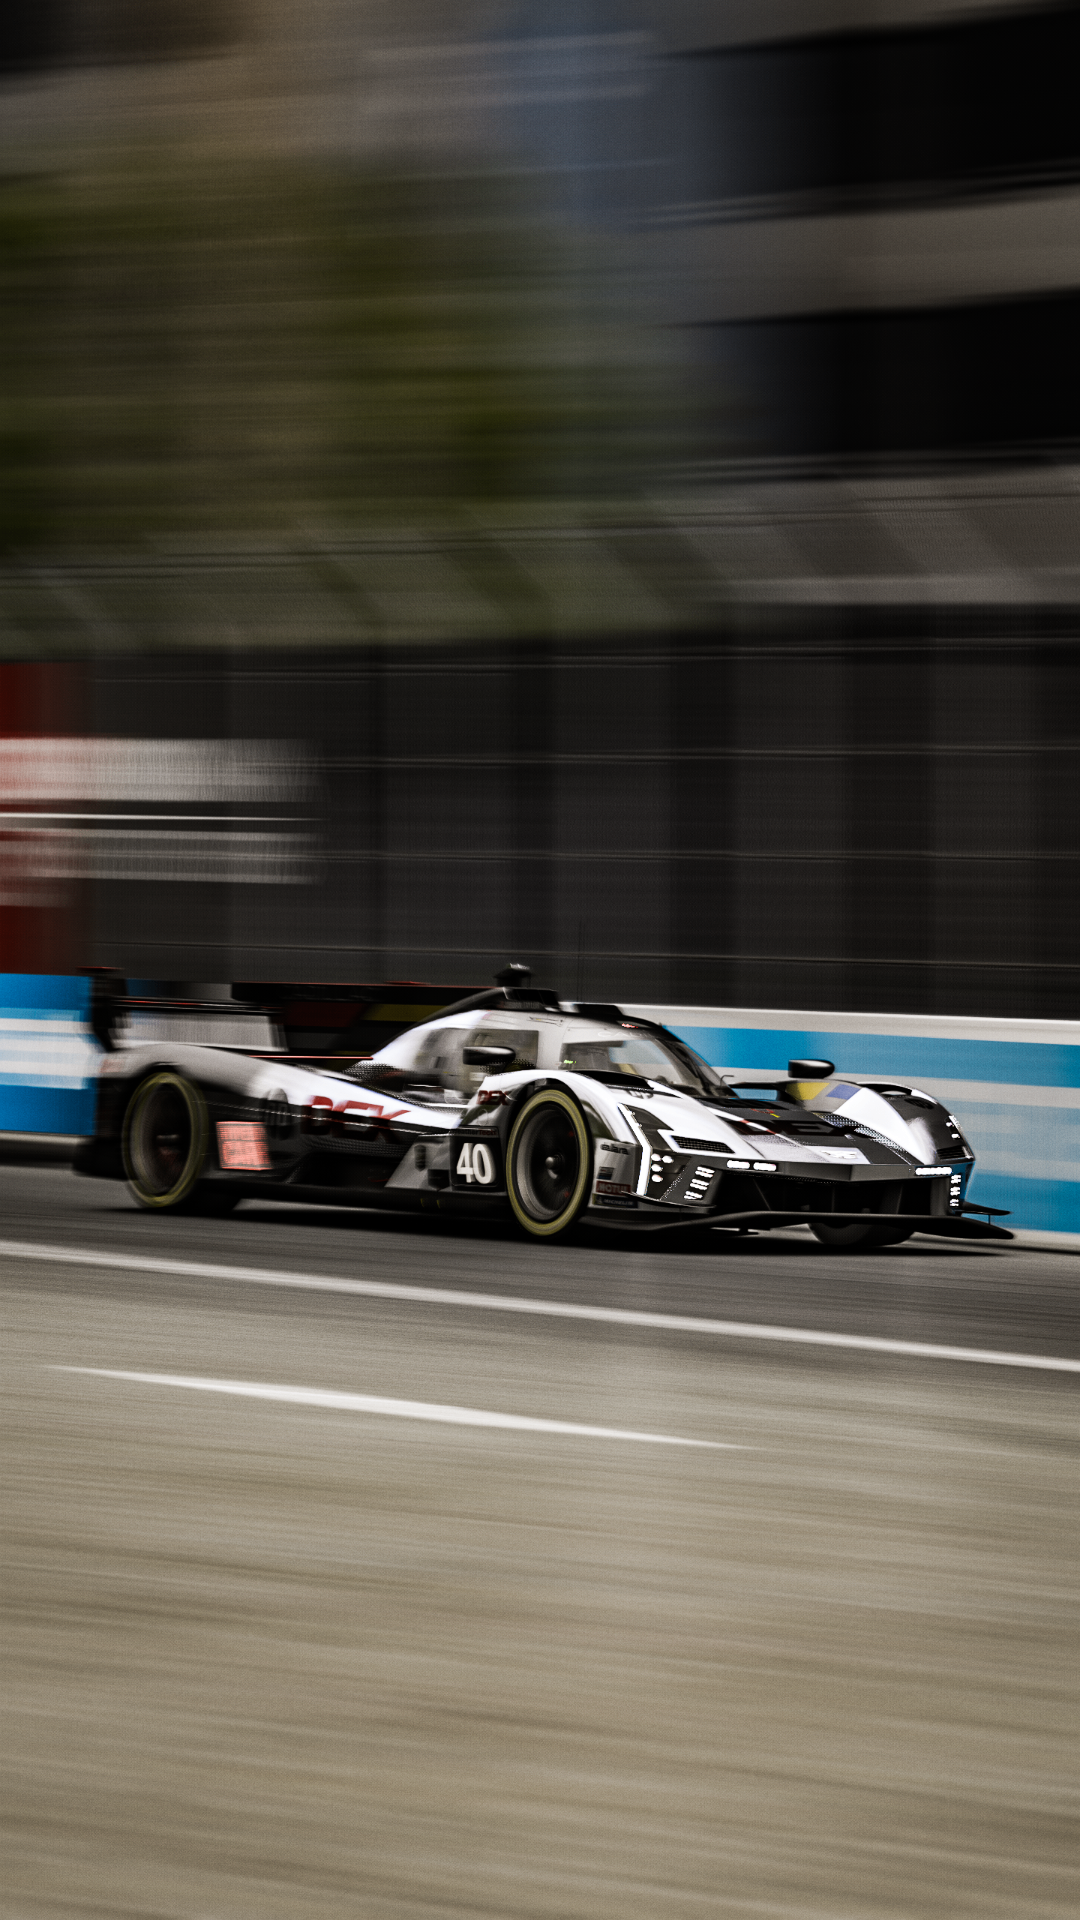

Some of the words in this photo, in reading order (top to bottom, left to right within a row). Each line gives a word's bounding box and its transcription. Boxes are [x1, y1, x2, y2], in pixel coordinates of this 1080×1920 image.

[477, 1090, 511, 1106] DEX
[301, 1095, 411, 1145] DEX
[457, 1143, 495, 1185] 40
